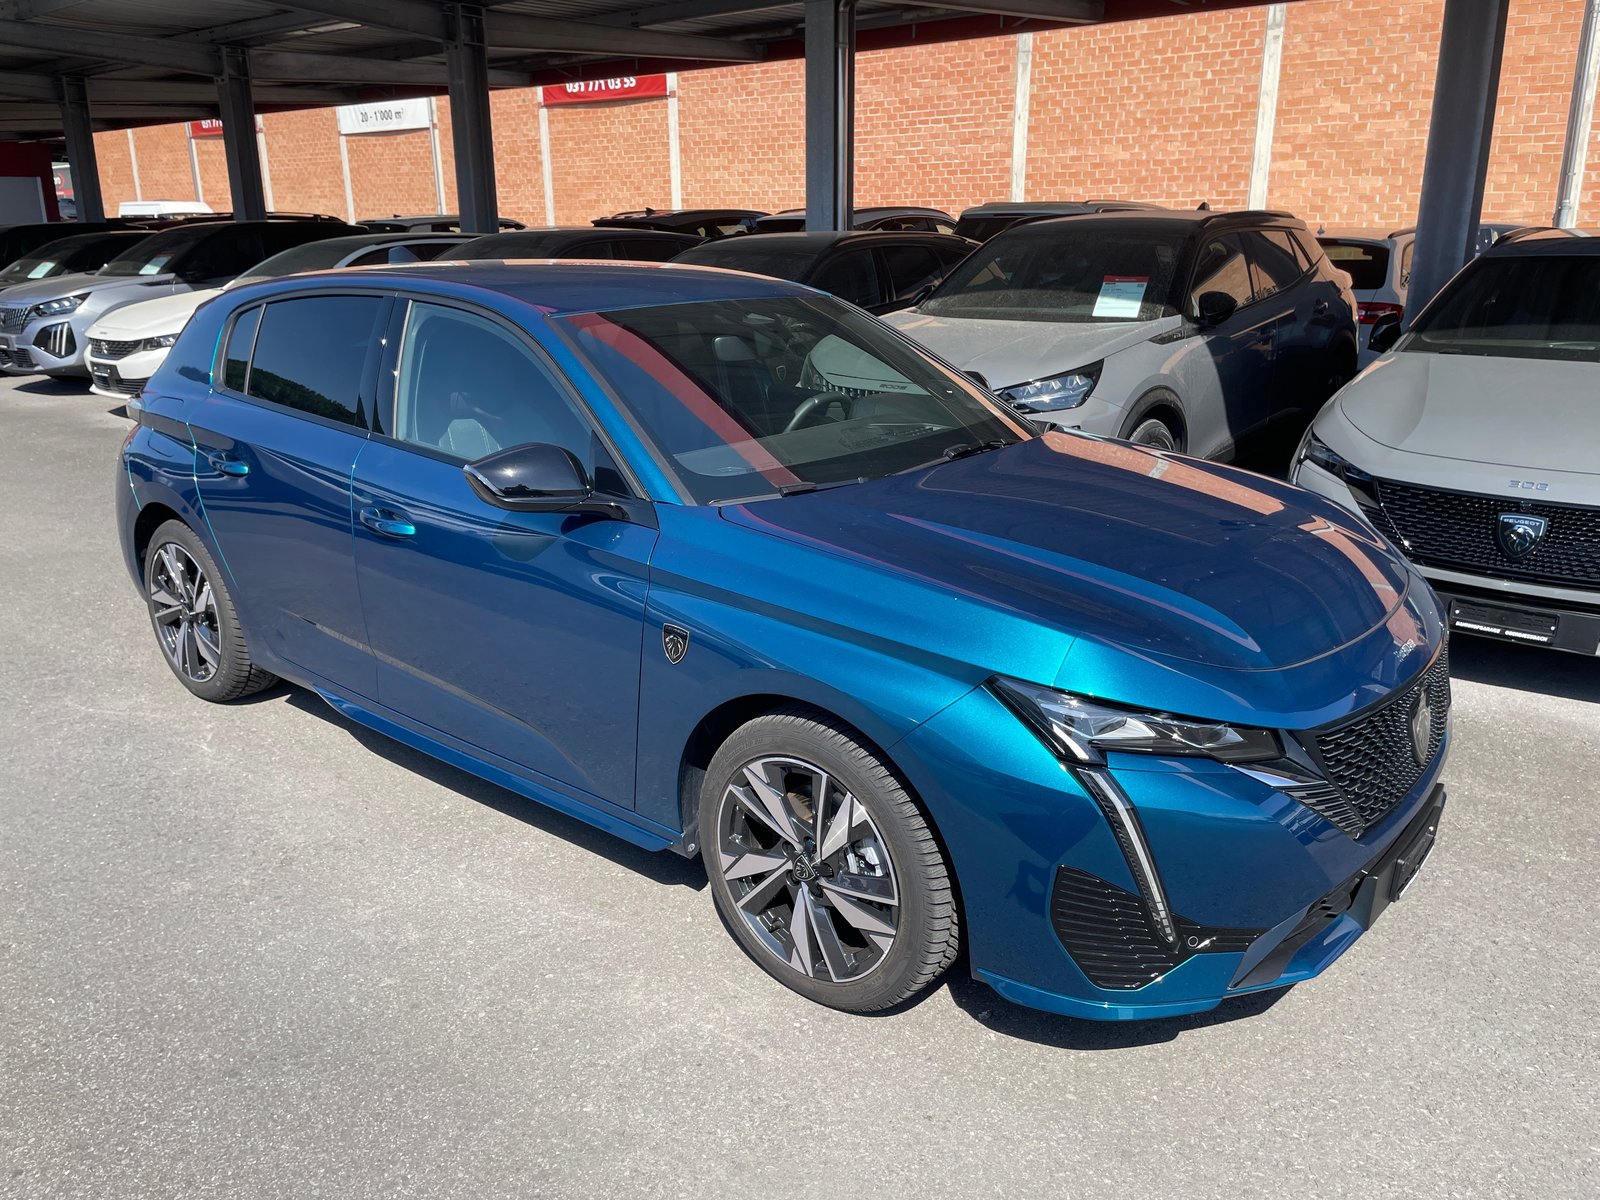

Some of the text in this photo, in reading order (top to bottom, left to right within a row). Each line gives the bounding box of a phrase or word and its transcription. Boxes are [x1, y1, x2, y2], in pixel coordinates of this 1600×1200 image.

[566, 82, 585, 93] 031
[607, 78, 621, 89] 03
[623, 76, 637, 88] 55
[360, 112, 369, 122] 20
[1503, 518, 1541, 528] PEUGEOT
